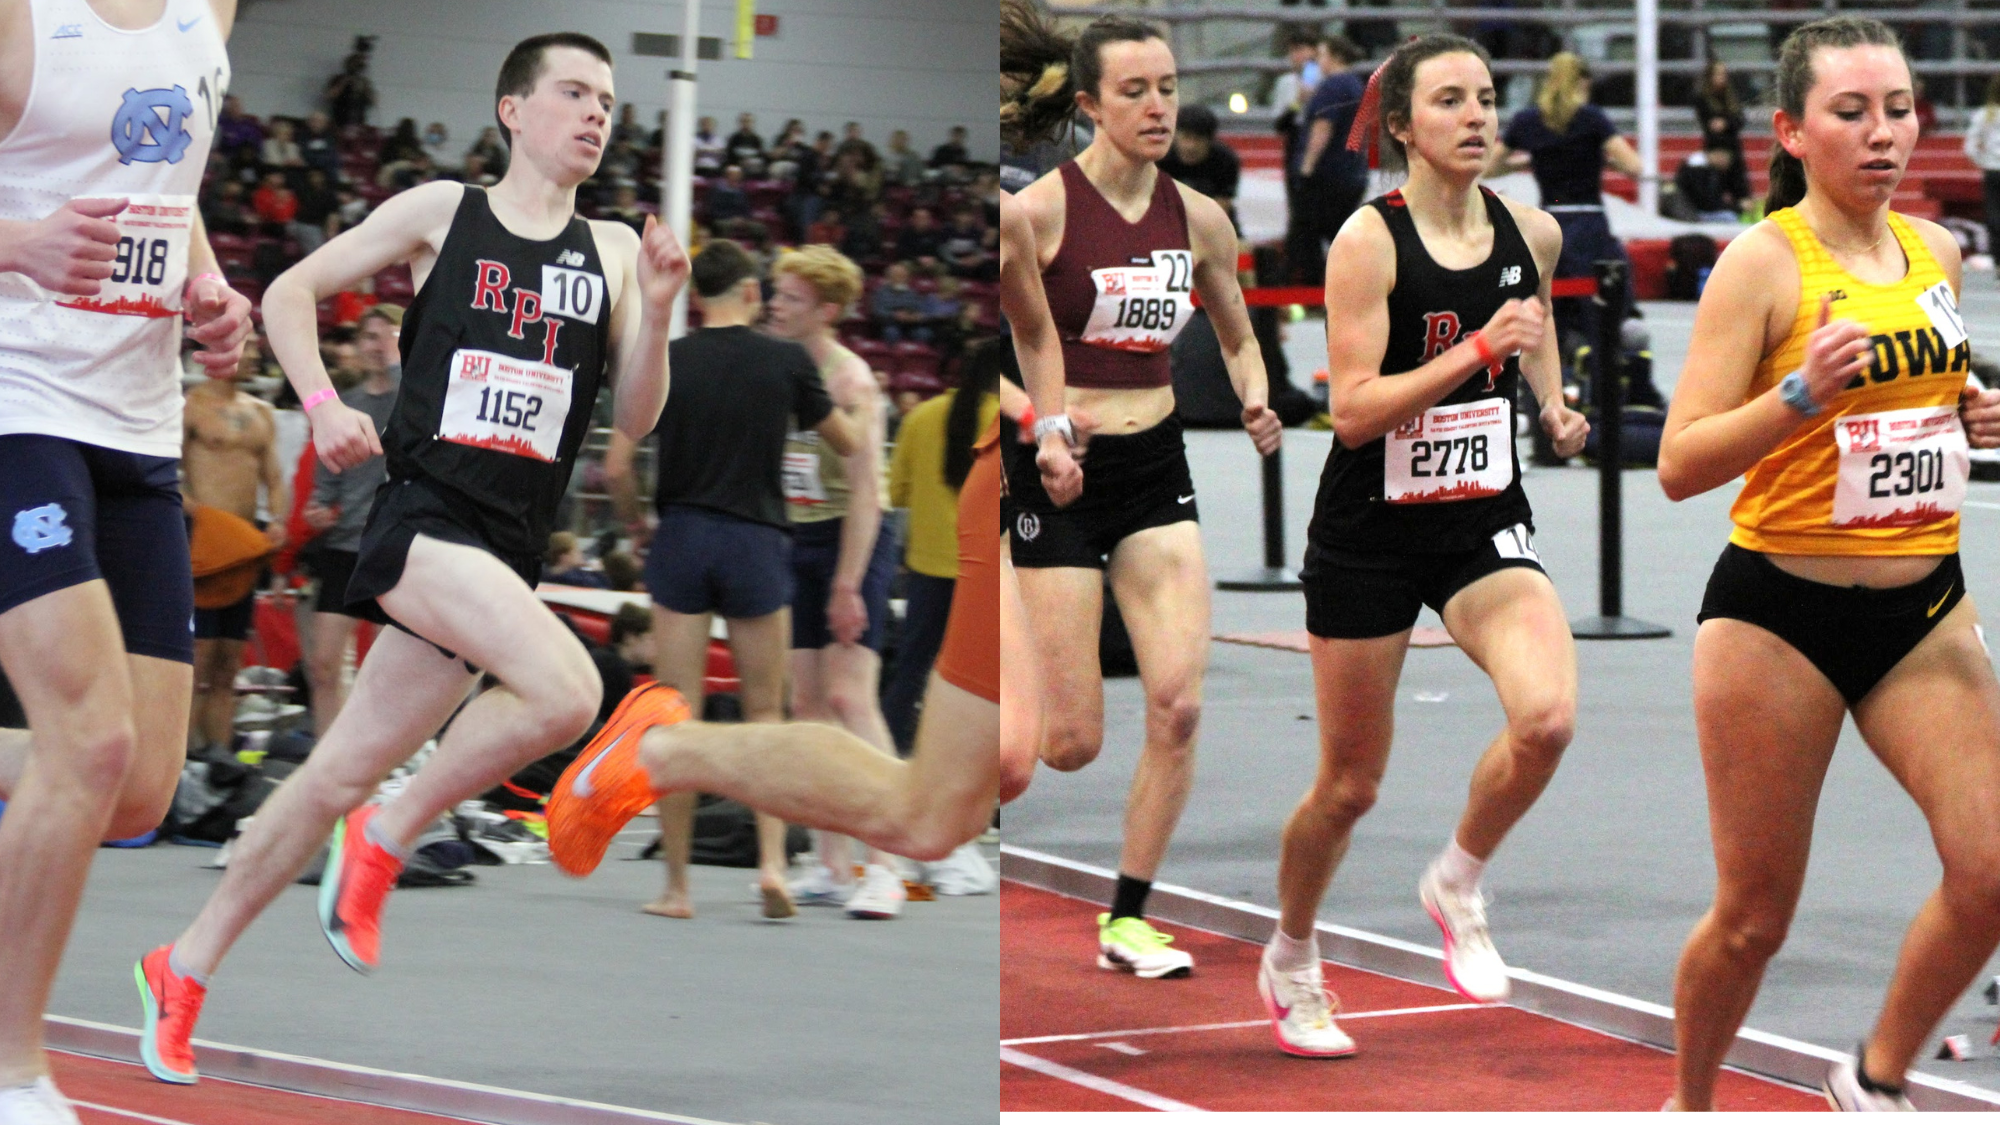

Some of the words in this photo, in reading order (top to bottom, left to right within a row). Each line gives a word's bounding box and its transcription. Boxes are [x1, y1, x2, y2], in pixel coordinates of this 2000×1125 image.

[553, 272, 593, 316] 10
[1160, 253, 1190, 293] 22
[1499, 265, 1522, 287] NB
[1113, 298, 1177, 330] 1889
[476, 386, 543, 432] 1152
[1433, 413, 1459, 424] BOSTON
[1460, 406, 1500, 420] UNIVERSITY
[1411, 434, 1489, 478] 2778
[1869, 446, 1945, 499] 2301
